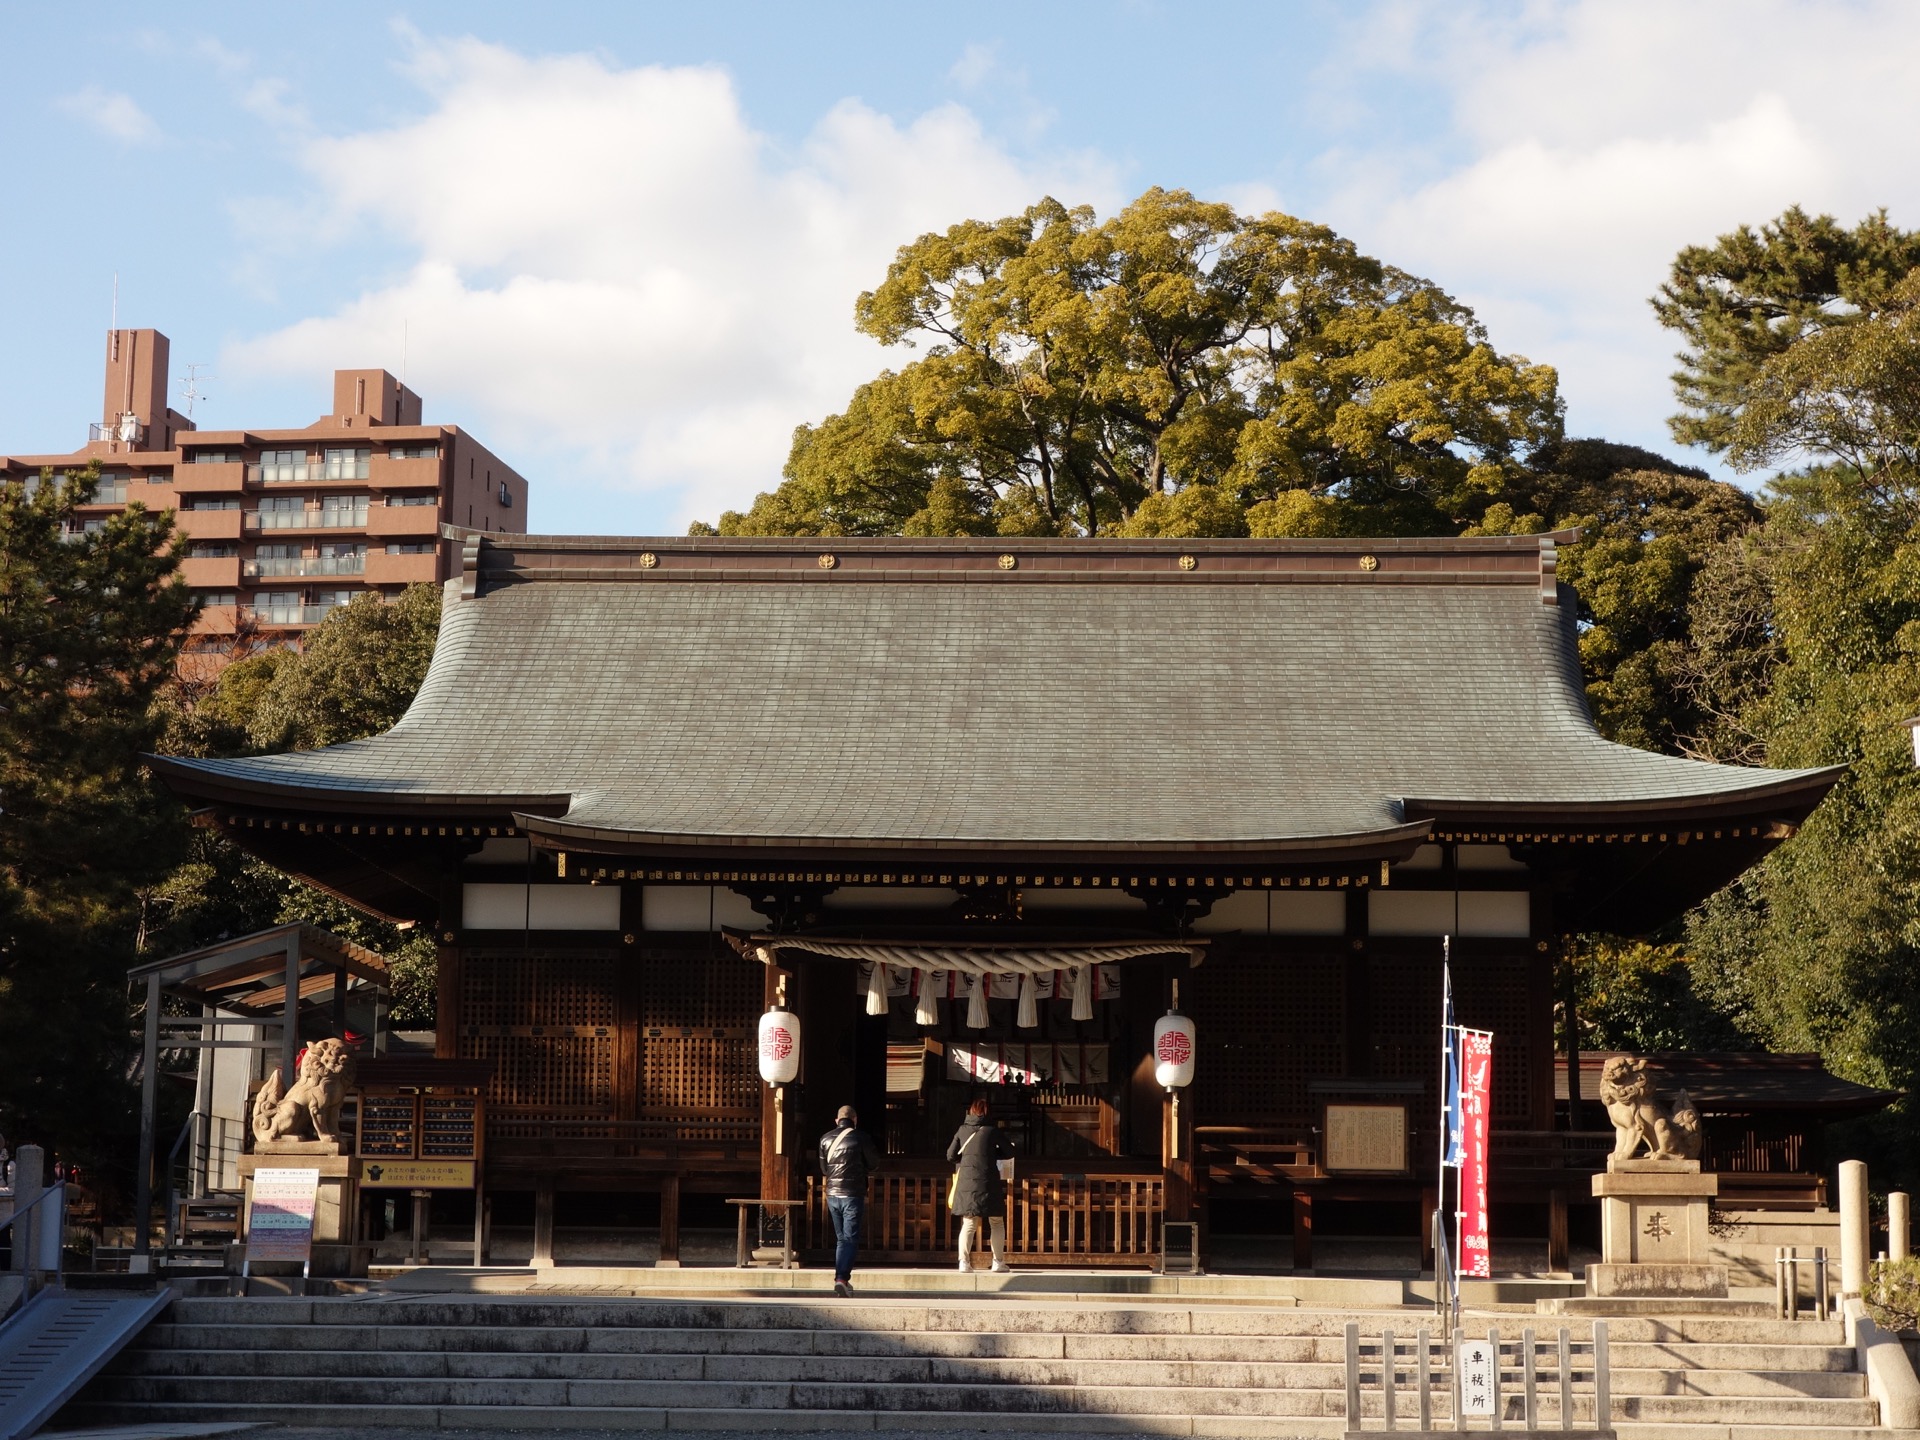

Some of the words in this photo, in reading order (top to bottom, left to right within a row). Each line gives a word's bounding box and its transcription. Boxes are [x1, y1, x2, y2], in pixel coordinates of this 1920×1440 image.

[1643, 1212, 1673, 1242] 奉
[1471, 1350, 1485, 1408] 車祓所
